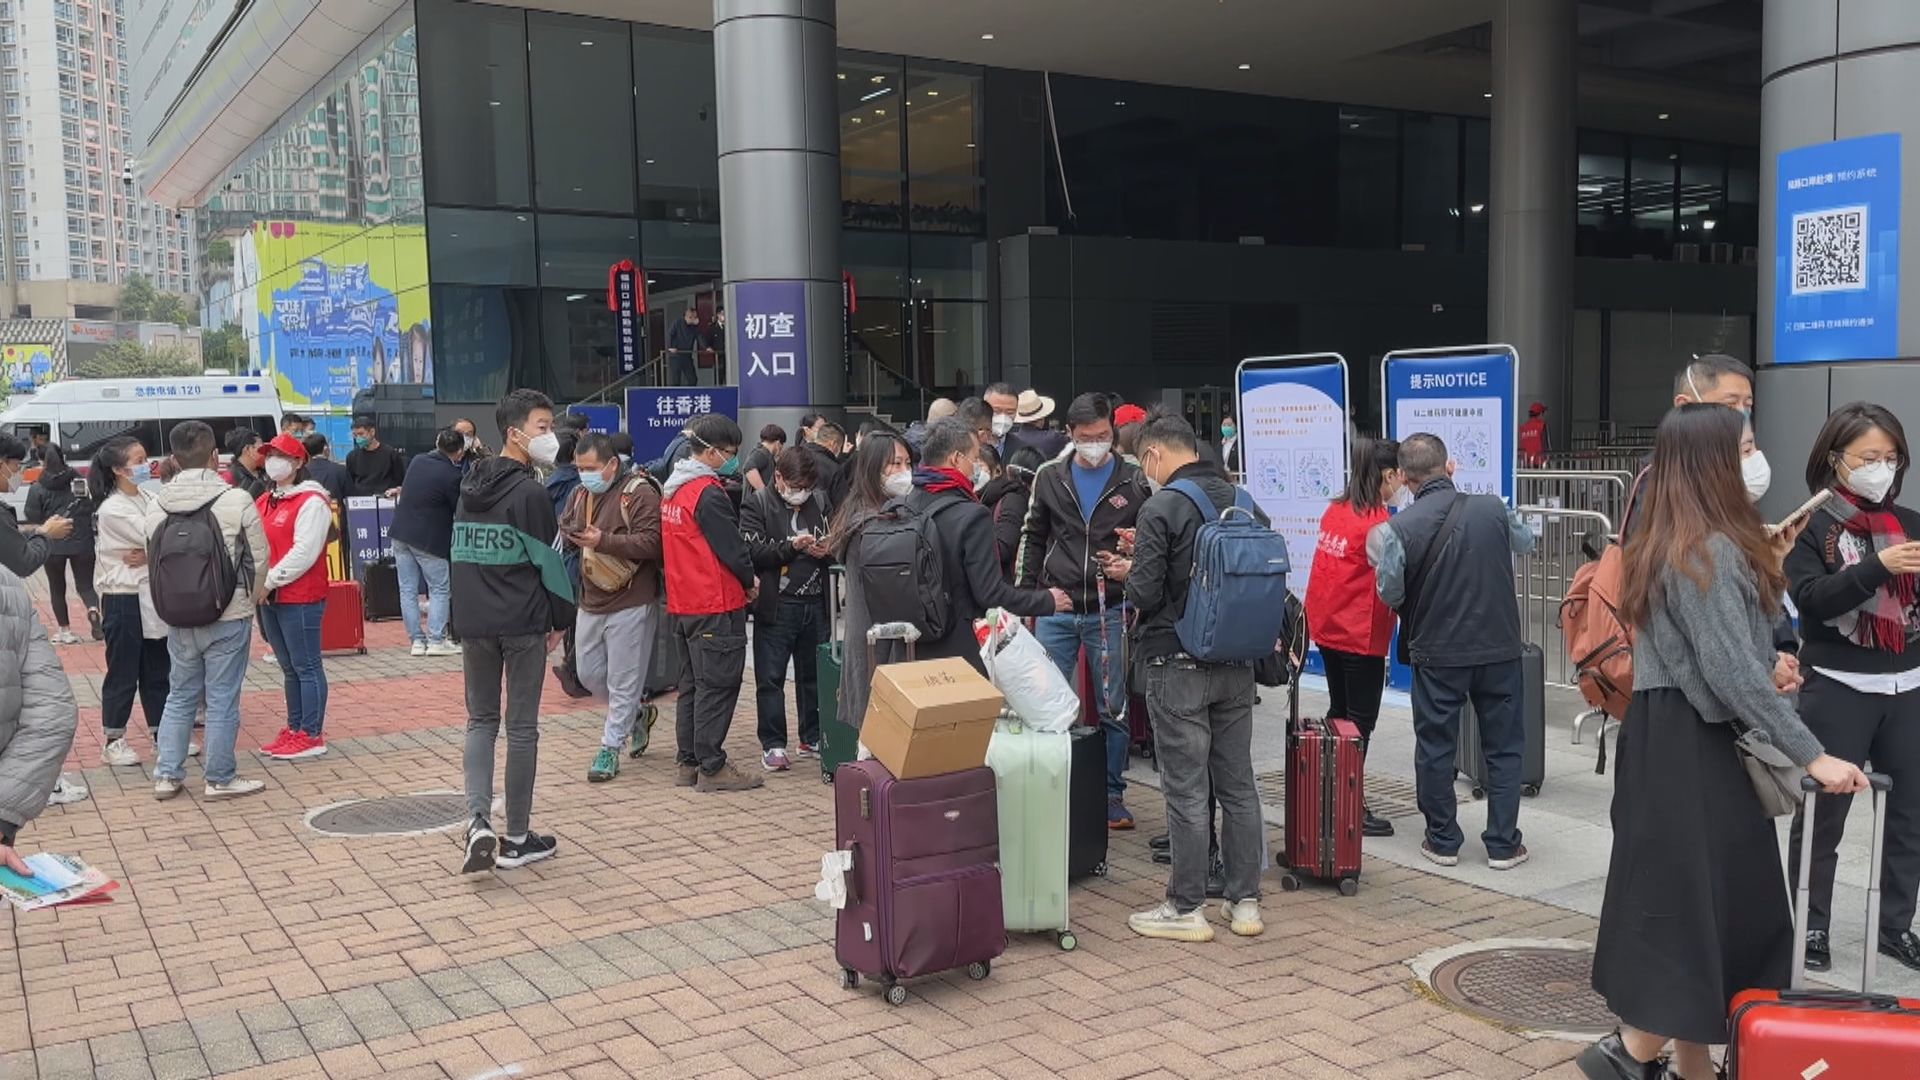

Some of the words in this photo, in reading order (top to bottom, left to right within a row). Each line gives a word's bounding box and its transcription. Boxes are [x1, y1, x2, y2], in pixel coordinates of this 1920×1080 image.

[744, 311, 795, 340] 初查
[746, 351, 796, 378] 入口
[656, 394, 712, 416] 往香港
[647, 417, 661, 428] To
